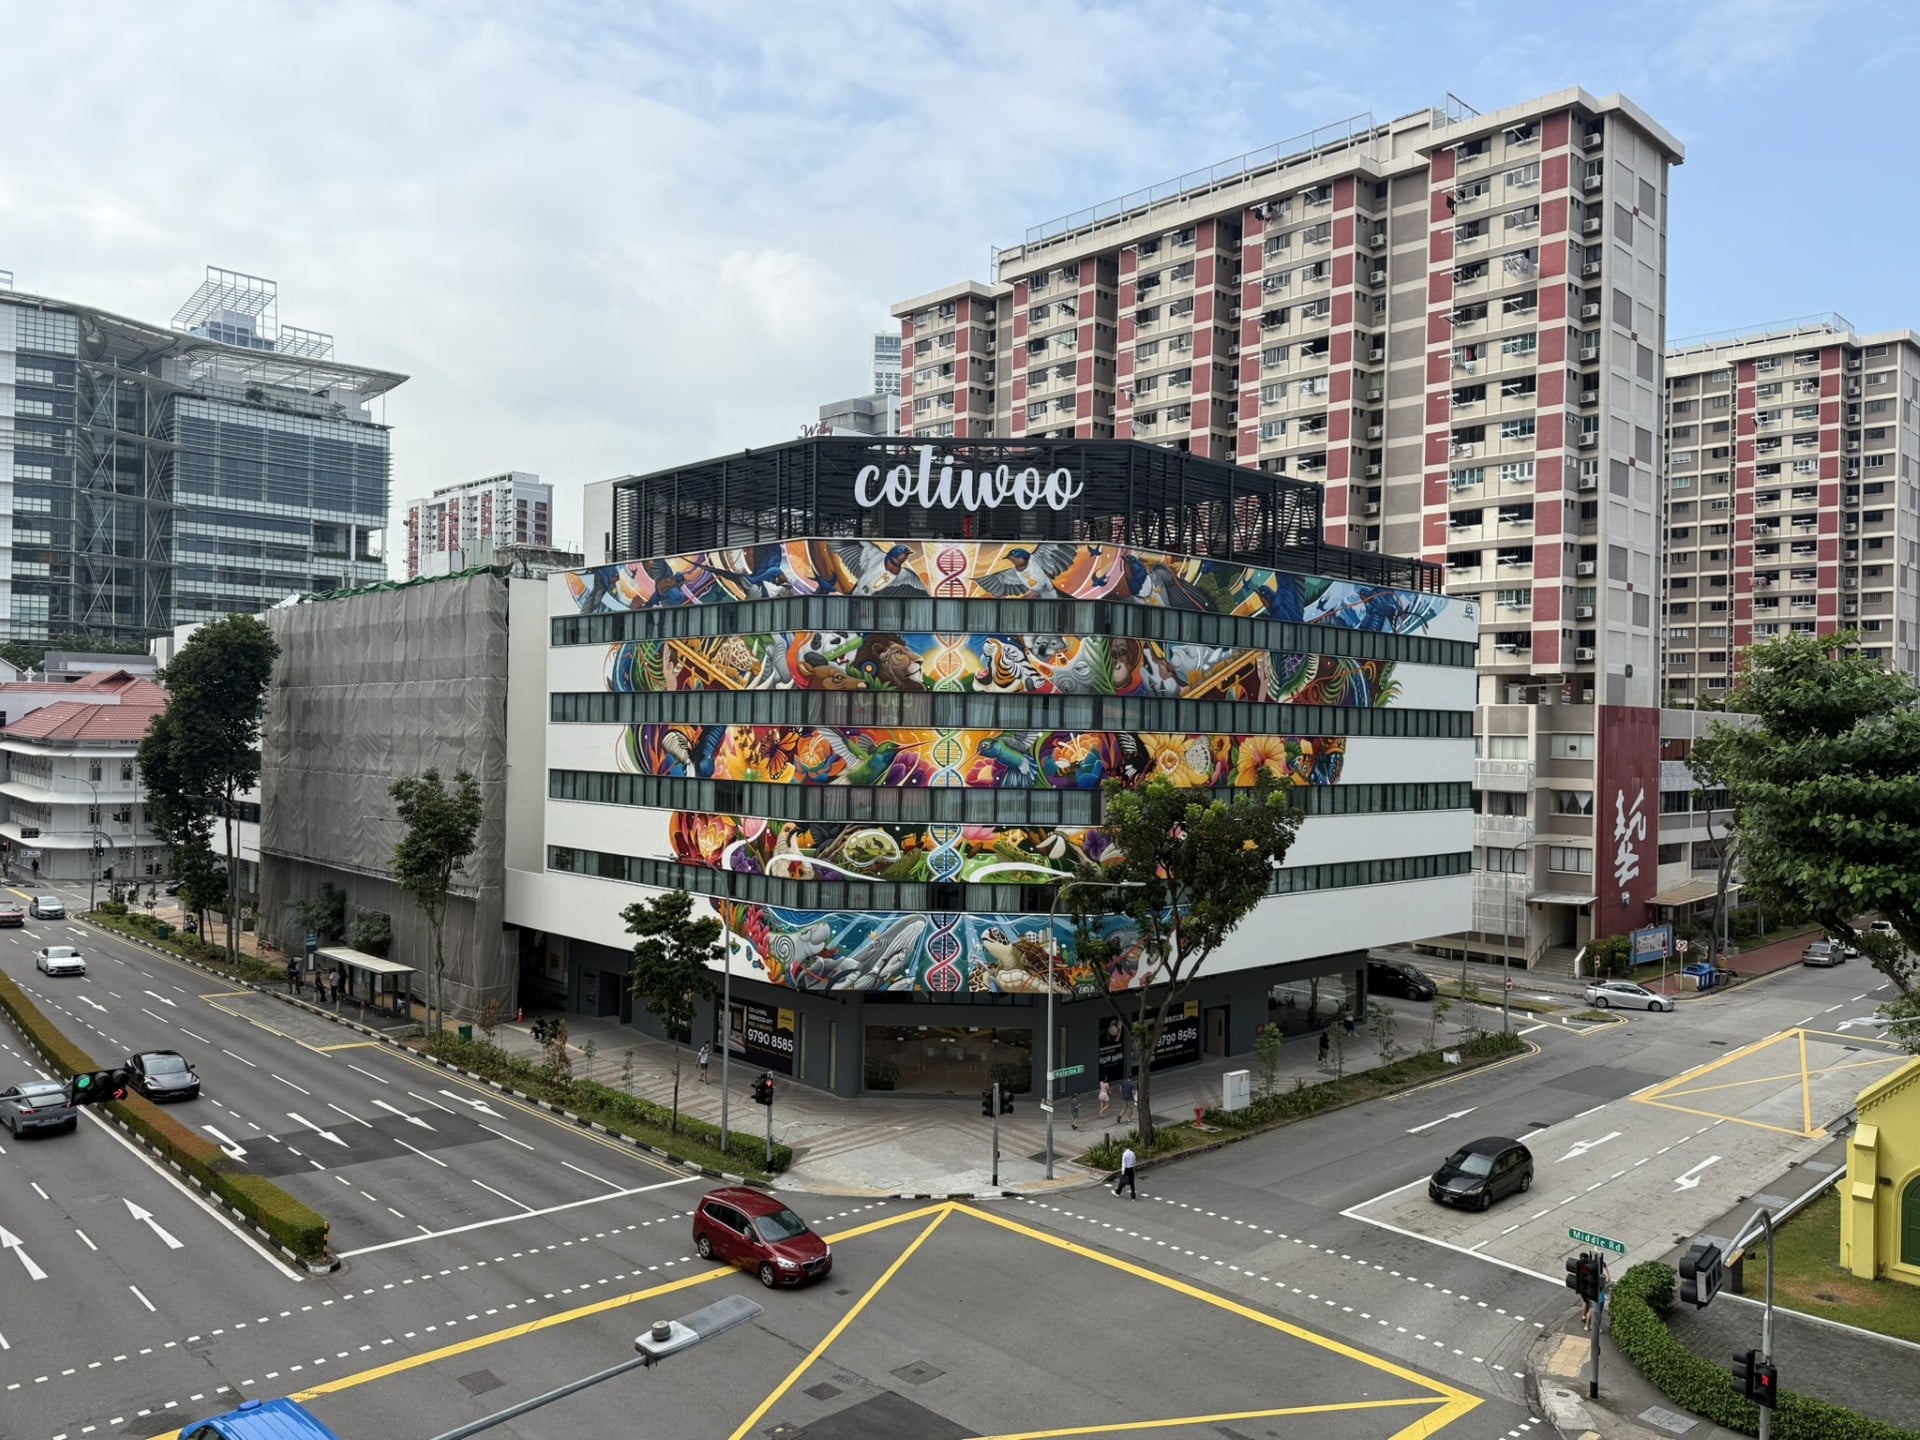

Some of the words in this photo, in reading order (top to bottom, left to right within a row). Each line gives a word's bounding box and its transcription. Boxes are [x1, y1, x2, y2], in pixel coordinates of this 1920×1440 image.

[854, 444, 1084, 511] coliwoo
[747, 1028, 770, 1045] 9790
[771, 1035, 793, 1052] 8585
[1177, 1028, 1197, 1042] 8585
[1573, 1230, 1606, 1247] Middle
[1609, 1241, 1621, 1252] Rd
